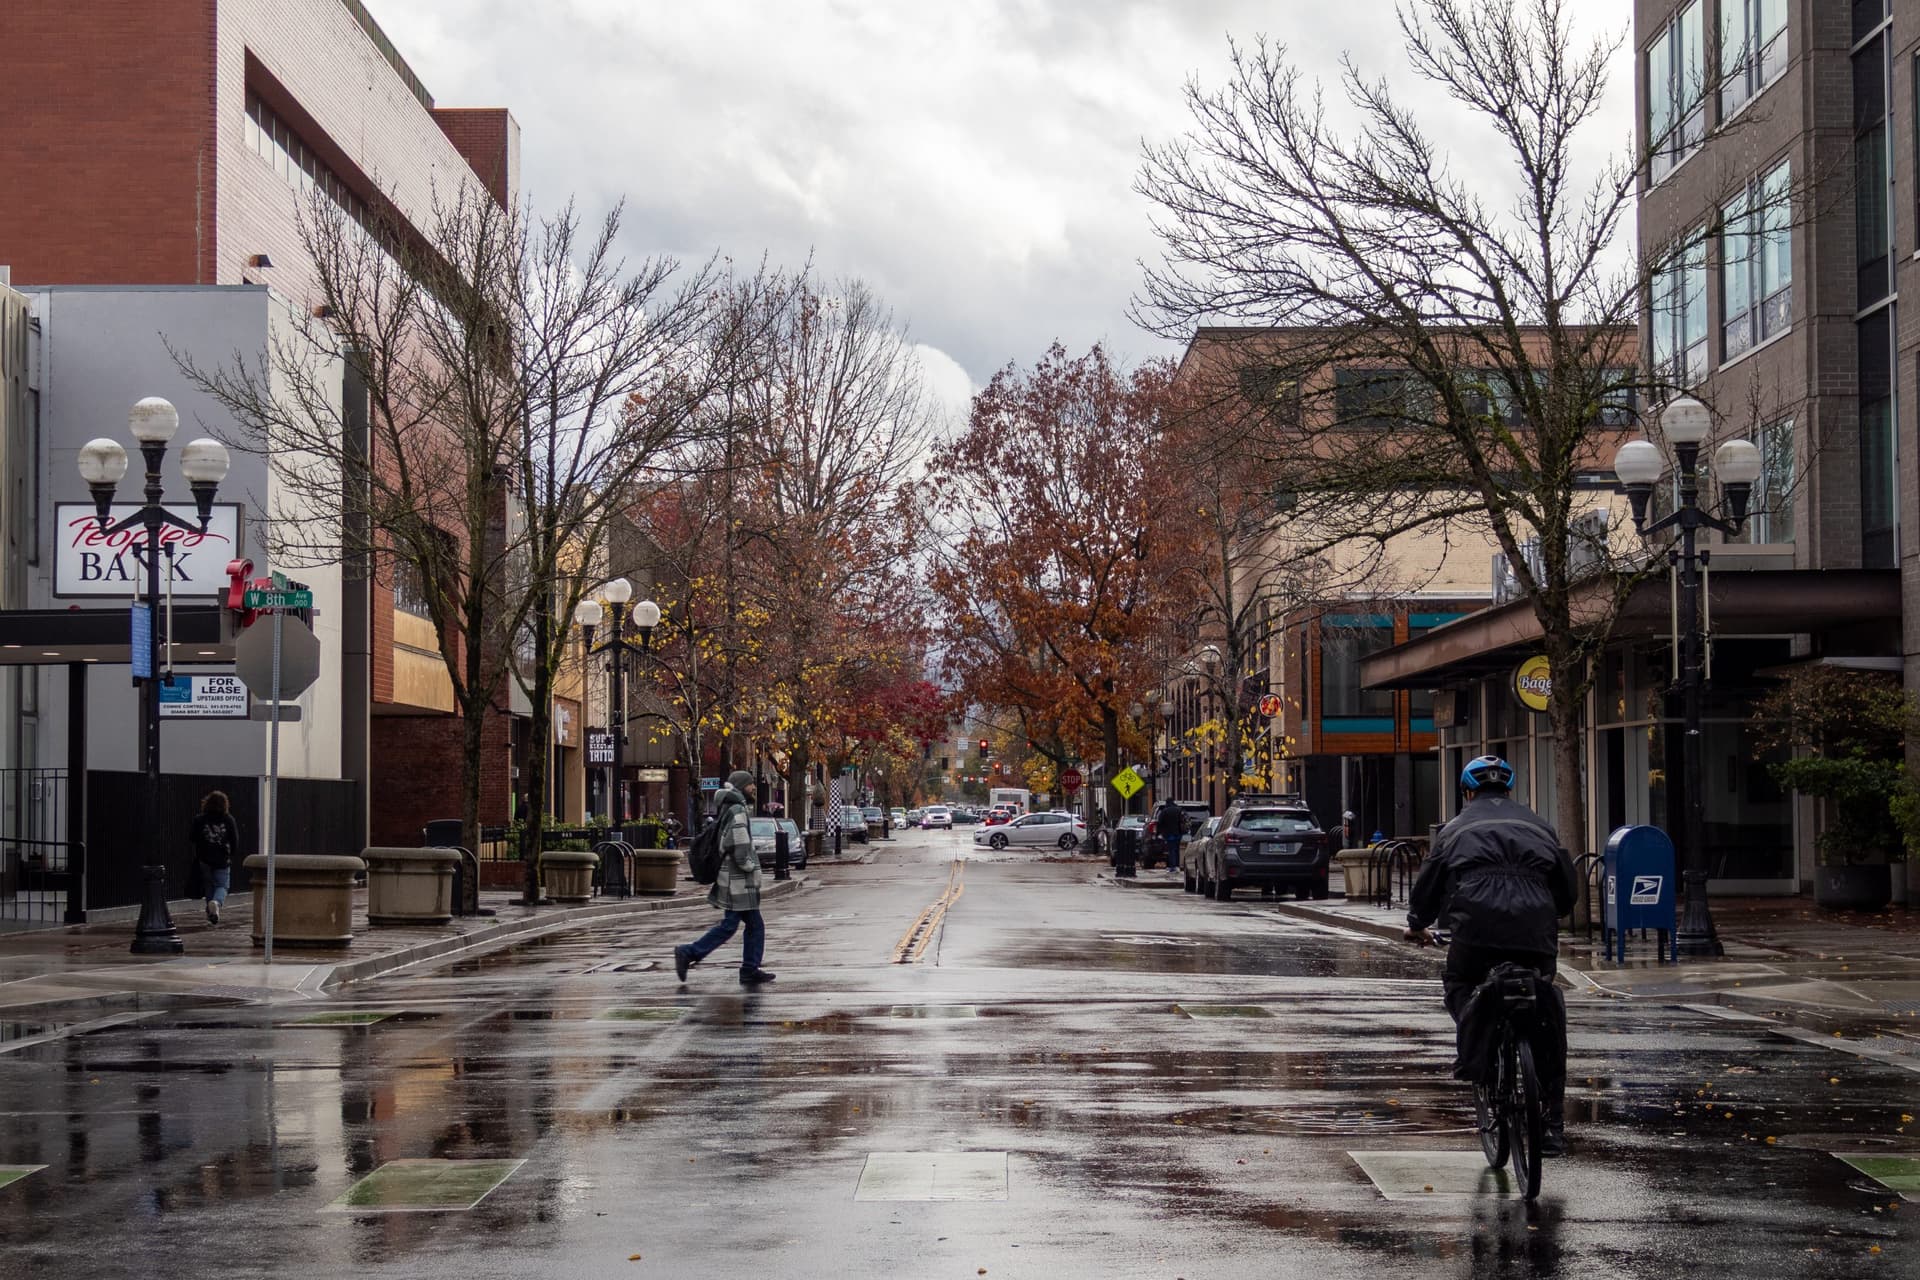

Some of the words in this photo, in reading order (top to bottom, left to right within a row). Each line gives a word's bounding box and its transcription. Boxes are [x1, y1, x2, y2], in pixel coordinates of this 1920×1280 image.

[79, 552, 193, 581] BAK
[251, 592, 260, 605] W
[266, 592, 286, 606] 8th
[208, 678, 234, 686] FOR
[201, 686, 241, 694] LEASE
[1062, 775, 1080, 784] STOP
